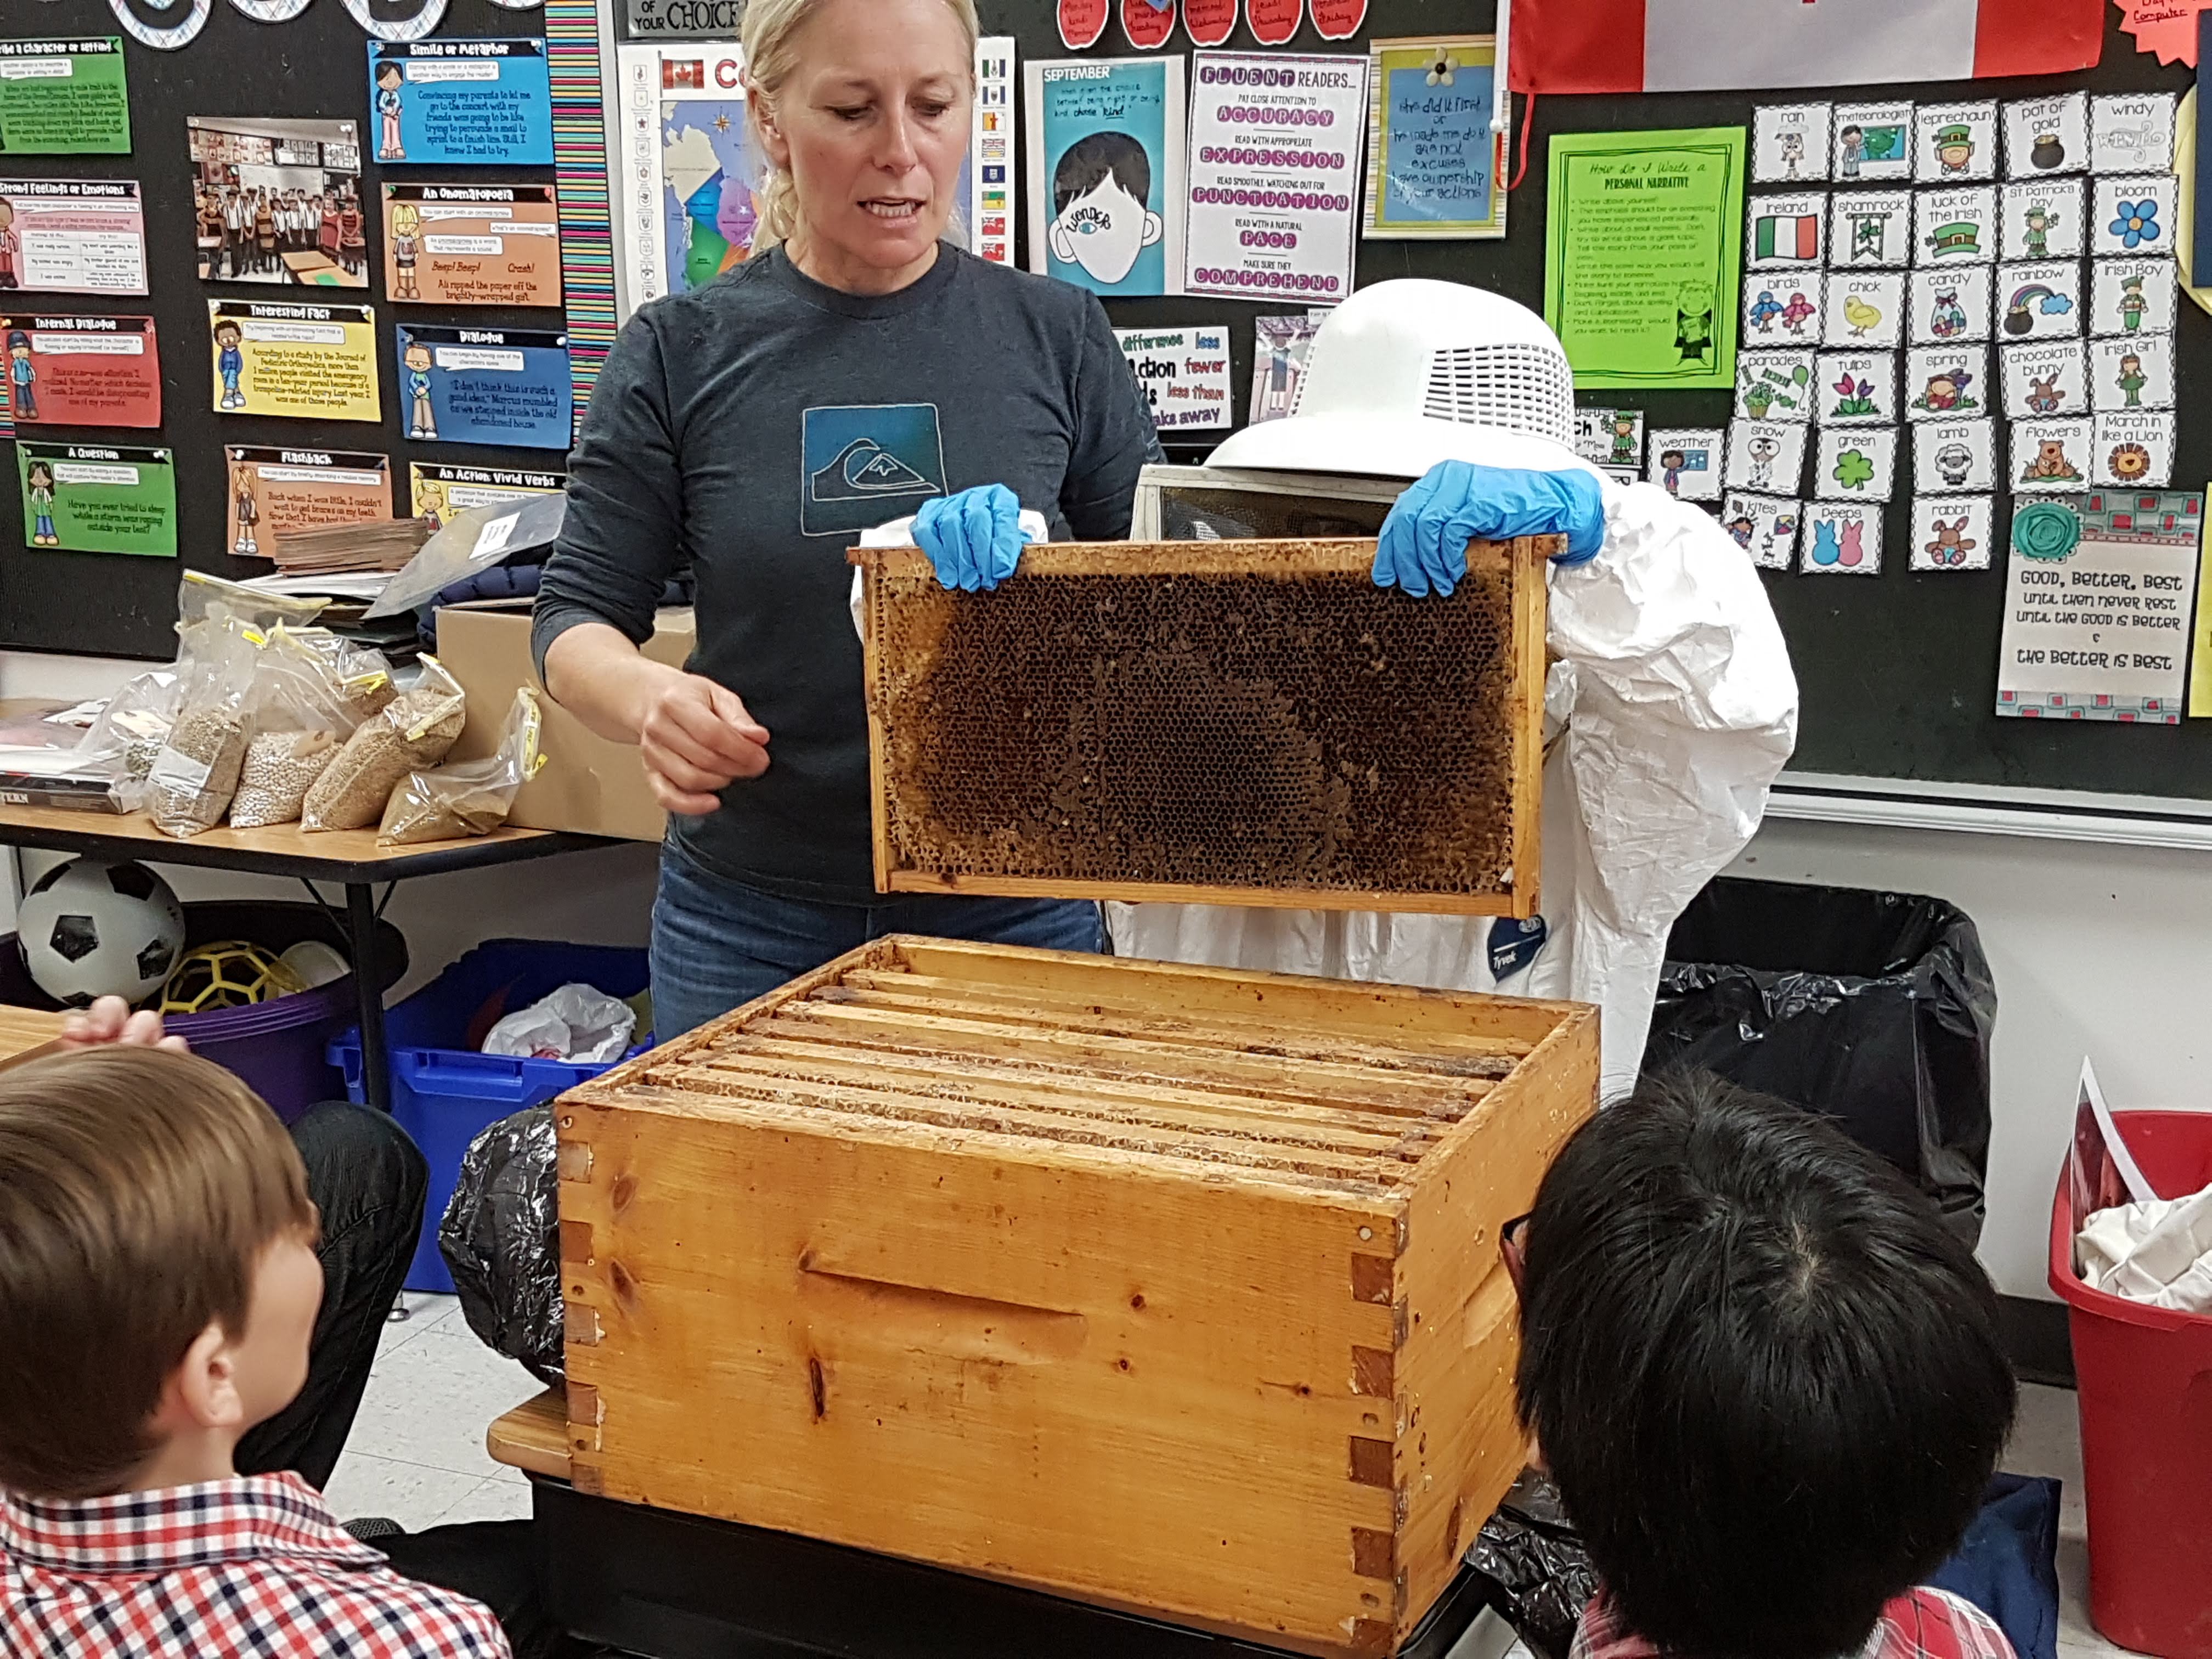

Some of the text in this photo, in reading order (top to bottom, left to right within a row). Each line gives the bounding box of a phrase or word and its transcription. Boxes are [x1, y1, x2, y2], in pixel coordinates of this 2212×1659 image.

[641, 1, 656, 13] OF
[2134, 8, 2186, 23] Computer
[634, 17, 665, 30] YOUR
[410, 43, 509, 56] Simile or Metaphor
[1044, 65, 1110, 82] SEPTEMBER
[1201, 67, 1294, 87] FLUENT
[458, 93, 469, 102] my
[471, 92, 499, 101] parents
[500, 91, 508, 99] to
[509, 89, 518, 99] let
[1238, 94, 1316, 106] PAY CLOSE ATTENTION TO
[1423, 98, 1442, 113] did
[2021, 101, 2067, 122] pot of
[2111, 104, 2155, 118] windy
[1218, 106, 1334, 126] ACCURACY
[1433, 115, 1447, 125] or
[1921, 110, 1992, 126] leprechaun
[2032, 118, 2061, 134] gold
[1235, 136, 1313, 147] READ WITH APPROPRIATE
[1415, 142, 1462, 155] are not
[1201, 148, 1345, 168] EXPRESSION
[1411, 159, 1466, 170] excuses
[1590, 163, 1613, 174] How
[1217, 176, 1232, 185] READ
[1267, 179, 1298, 189] WATCHING
[1300, 181, 1312, 190] OUT
[1313, 182, 1325, 190] FOR
[1422, 170, 1485, 186] ownership
[1605, 176, 1690, 190] PERSONAL NARRATIVE
[30, 183, 67, 195] Feelings
[69, 184, 80, 195] or
[82, 184, 125, 195] Emotions
[423, 188, 514, 201] An Onomatopoeia
[2115, 185, 2158, 197] bloom
[1192, 187, 1349, 211] PUNCTUATION
[1838, 199, 1905, 212] shamrock
[1932, 194, 1978, 208] luck of
[1766, 201, 1808, 214] Ireland
[1928, 207, 1982, 221] the Irish
[1066, 207, 1111, 233] WONDER
[1235, 219, 1250, 227] READ
[1252, 220, 1268, 228] WITH
[1276, 221, 1302, 231] NATURAL
[1240, 231, 1296, 249] PACE
[1244, 259, 1291, 270] MAKE SURE THEY
[2105, 264, 2164, 277] Irish Boy
[1195, 268, 1339, 291] COMPREHEND
[1928, 274, 1972, 287] candy
[2012, 269, 2065, 281] rainbow
[1767, 278, 1801, 290] birds
[1849, 280, 1882, 293] chick
[251, 305, 331, 319] Interesting Fact
[35, 318, 117, 330] Internal Dialogue
[460, 330, 504, 345] Dialogue
[1122, 331, 1221, 353] difference less
[2010, 346, 2078, 364] chocolate
[2104, 344, 2133, 356] Irish
[1184, 358, 1227, 375] fewer
[1748, 356, 1803, 367] parades
[1838, 359, 1872, 371] tulips
[1926, 354, 1968, 368] spring
[2023, 362, 2065, 376] bunny
[1167, 382, 1189, 399] less
[1192, 384, 1224, 401] than
[1179, 407, 1221, 426] away
[2105, 415, 2149, 427] March
[1751, 425, 1786, 437] snow
[1937, 427, 1970, 438] lamb
[2025, 426, 2081, 438] flowers
[2102, 430, 2164, 442] like a Lion
[1659, 437, 1715, 448] weather
[1838, 436, 1876, 448] green
[69, 448, 120, 460] A Question
[281, 451, 332, 465] Flashback
[439, 468, 454, 479] An
[493, 473, 522, 485] Vivid
[524, 475, 556, 487] Verbs
[1747, 500, 1778, 515] kites
[1931, 504, 1973, 516] rabbit
[1493, 950, 1517, 970] Tyvek
